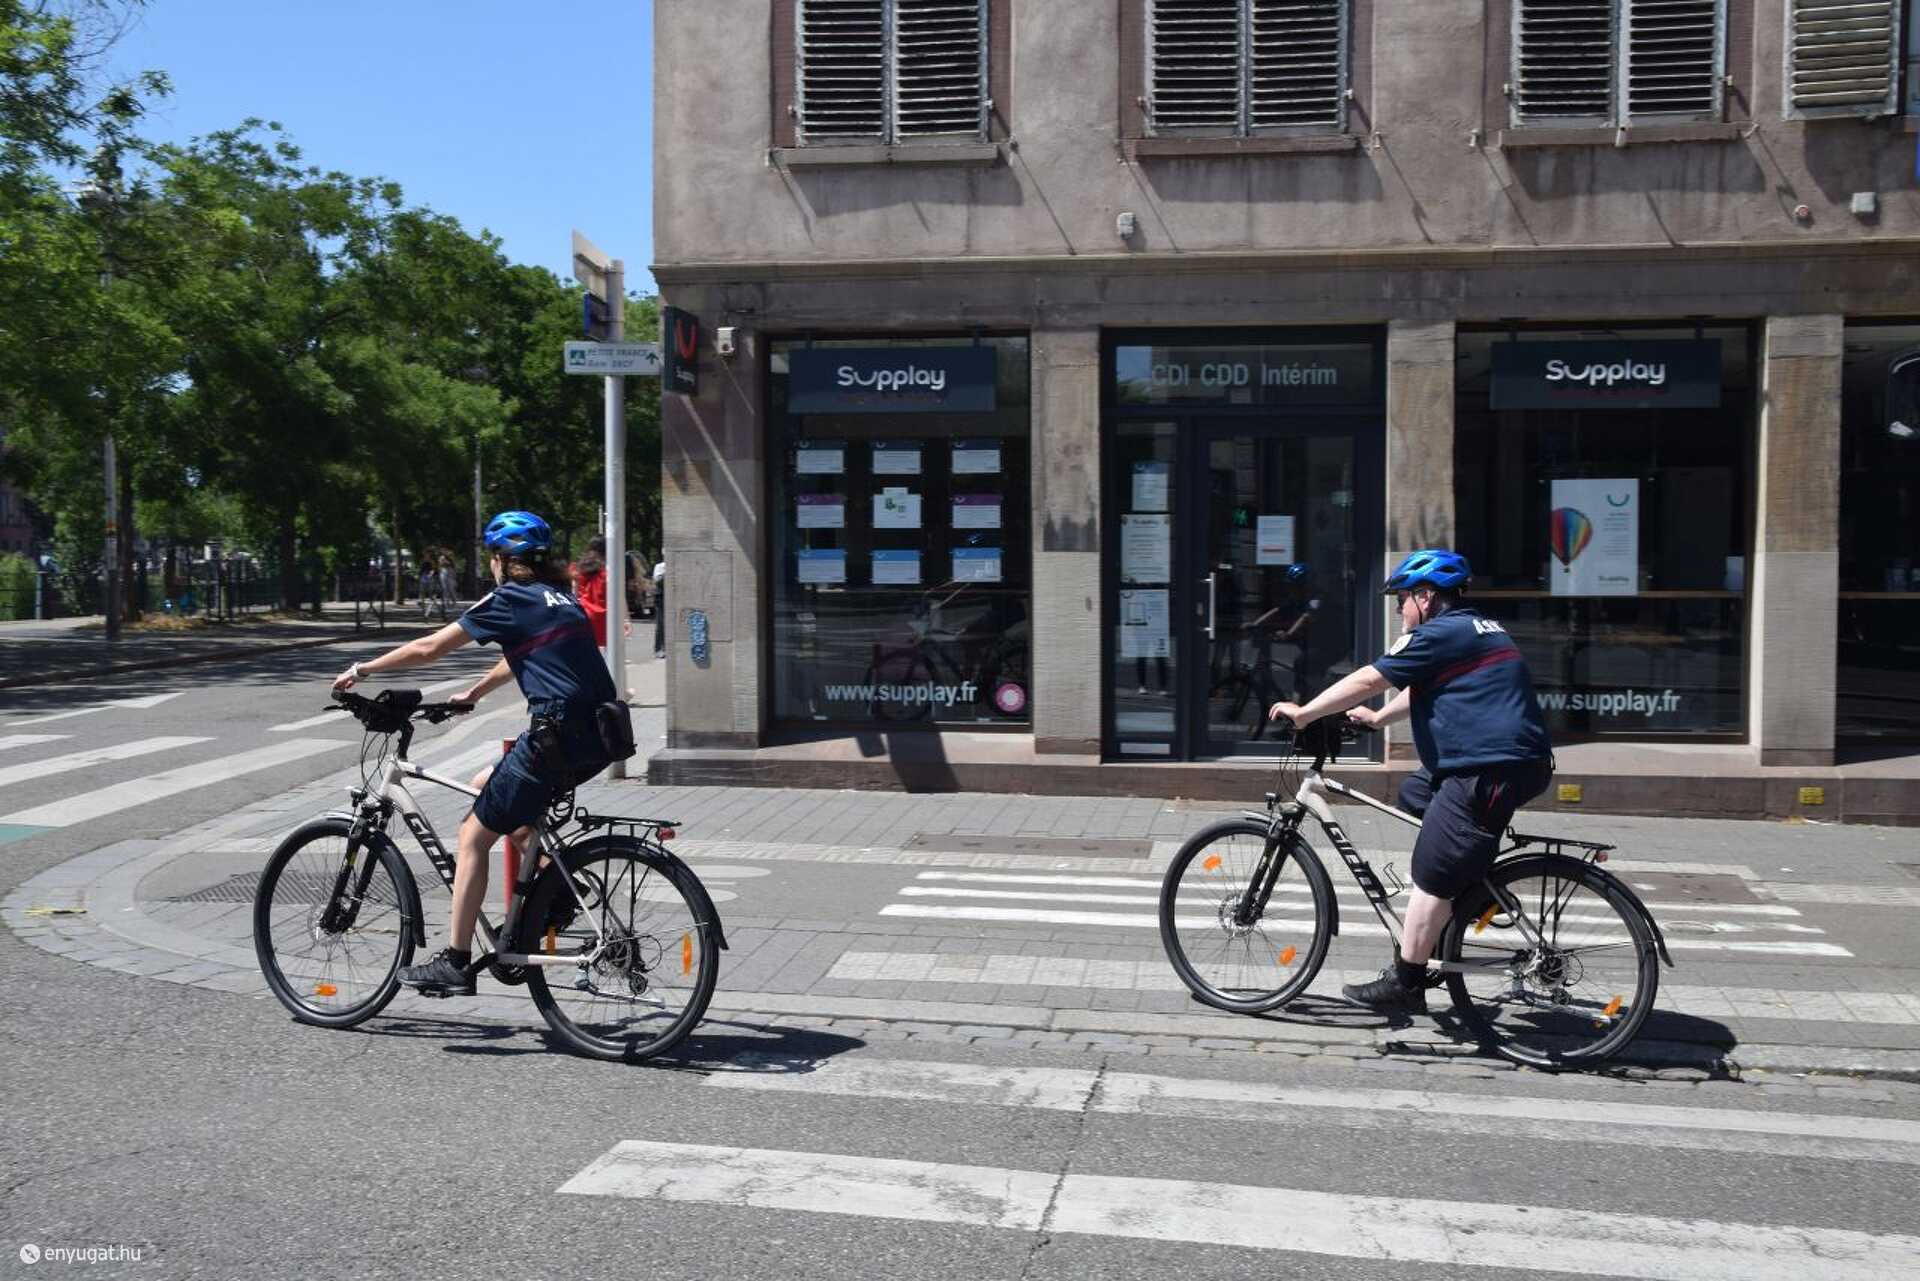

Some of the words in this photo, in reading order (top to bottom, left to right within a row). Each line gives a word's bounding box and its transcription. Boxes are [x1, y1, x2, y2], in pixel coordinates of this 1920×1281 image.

[837, 365, 945, 391] Supplay
[1151, 363, 1189, 386] CDI
[1201, 363, 1249, 386] CDD
[1261, 361, 1337, 385] Intérim
[1545, 359, 1666, 386] Supplay
[825, 680, 977, 707] www.supplay.fr
